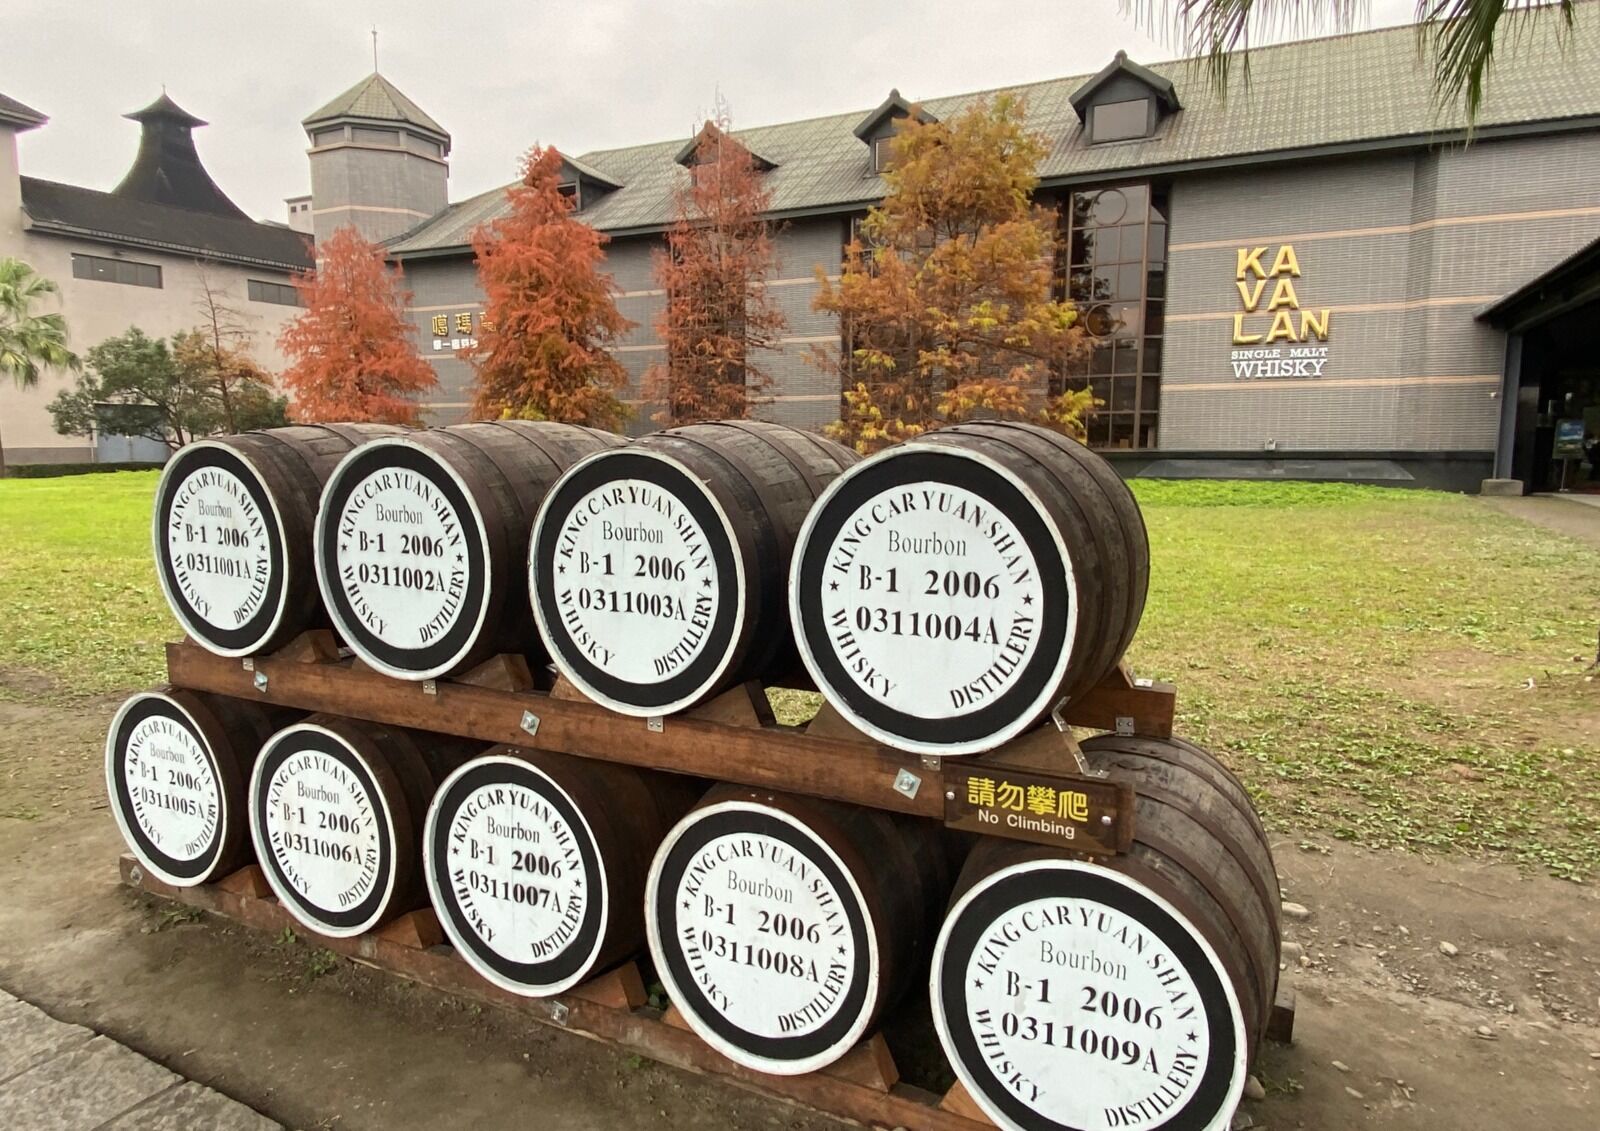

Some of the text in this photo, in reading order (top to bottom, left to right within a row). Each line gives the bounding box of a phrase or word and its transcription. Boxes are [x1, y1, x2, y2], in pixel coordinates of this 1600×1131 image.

[1236, 245, 1300, 281] KA
[1236, 278, 1299, 312] VA
[1232, 309, 1330, 345] LAN
[1232, 348, 1328, 360] SINGLE MALT
[1232, 359, 1327, 378] WHISKY
[172, 472, 264, 538] KING CAR YUAN SHAN
[198, 499, 232, 518] Bourbon
[342, 473, 461, 547] KING CAR YUAN SHAN
[376, 504, 423, 524] Bourbon
[186, 524, 249, 548] B-1 2006
[359, 531, 443, 557] B-1 2006
[560, 486, 709, 570] KING CAR YUAN SHAN
[603, 520, 663, 543] Bourbon
[833, 490, 1032, 585] KING CAR YUAN SHAN
[888, 530, 966, 556] Bourbon
[187, 553, 252, 579] 0311001A
[359, 564, 445, 592] 0311002A
[580, 552, 686, 582] B-1 2006
[859, 565, 1000, 599] B-1 2006
[175, 555, 268, 624] WHISKY DISTILLERY
[343, 565, 464, 643] WHISKY DISTILLERY
[579, 588, 686, 621] 0311003A
[560, 589, 713, 676] WHISKY DISTILLERY
[856, 606, 999, 645] 0311004A
[831, 608, 1034, 709] WHISKY DISTILLERY
[129, 733, 144, 766] KING
[142, 721, 160, 737] CAR
[161, 721, 189, 747] YUAN
[150, 743, 185, 763] Bourbon
[141, 761, 201, 791] B-1 2006
[270, 756, 374, 827] KING CAR YUAN SHAN
[298, 781, 339, 804] Bourbon
[142, 787, 205, 819] 0311005A
[284, 803, 360, 834] B-1 2006
[968, 777, 1088, 822] 請勿攀爬
[132, 786, 216, 856] WHISKY DISTILLERY
[454, 790, 580, 871] KING CAR YUAN SHAN
[488, 816, 540, 843] Bourbon
[978, 809, 1075, 839] No Climbing
[284, 832, 362, 865] 0311006A
[471, 839, 561, 879] B-1 2006
[272, 832, 377, 906] WHISKY DISTILLERY
[729, 870, 792, 903] Bourbon
[470, 870, 562, 913] 0311007A
[686, 840, 846, 938] KING CAR YUAN SHAN
[454, 869, 582, 958] WHISKY DISTILLERY
[704, 894, 820, 944] B-1 2006
[702, 930, 819, 983] 0311008A
[977, 905, 1198, 1021] KING CAR YUAN SHAN
[1041, 940, 1126, 980] Bourbon
[683, 927, 847, 1032] WHISKY DISTILLERY
[1006, 970, 1163, 1030] B-1 2006
[1002, 1013, 1160, 1075] 0311009A
[975, 1009, 1199, 1128] WHISKY DISTILLERY
